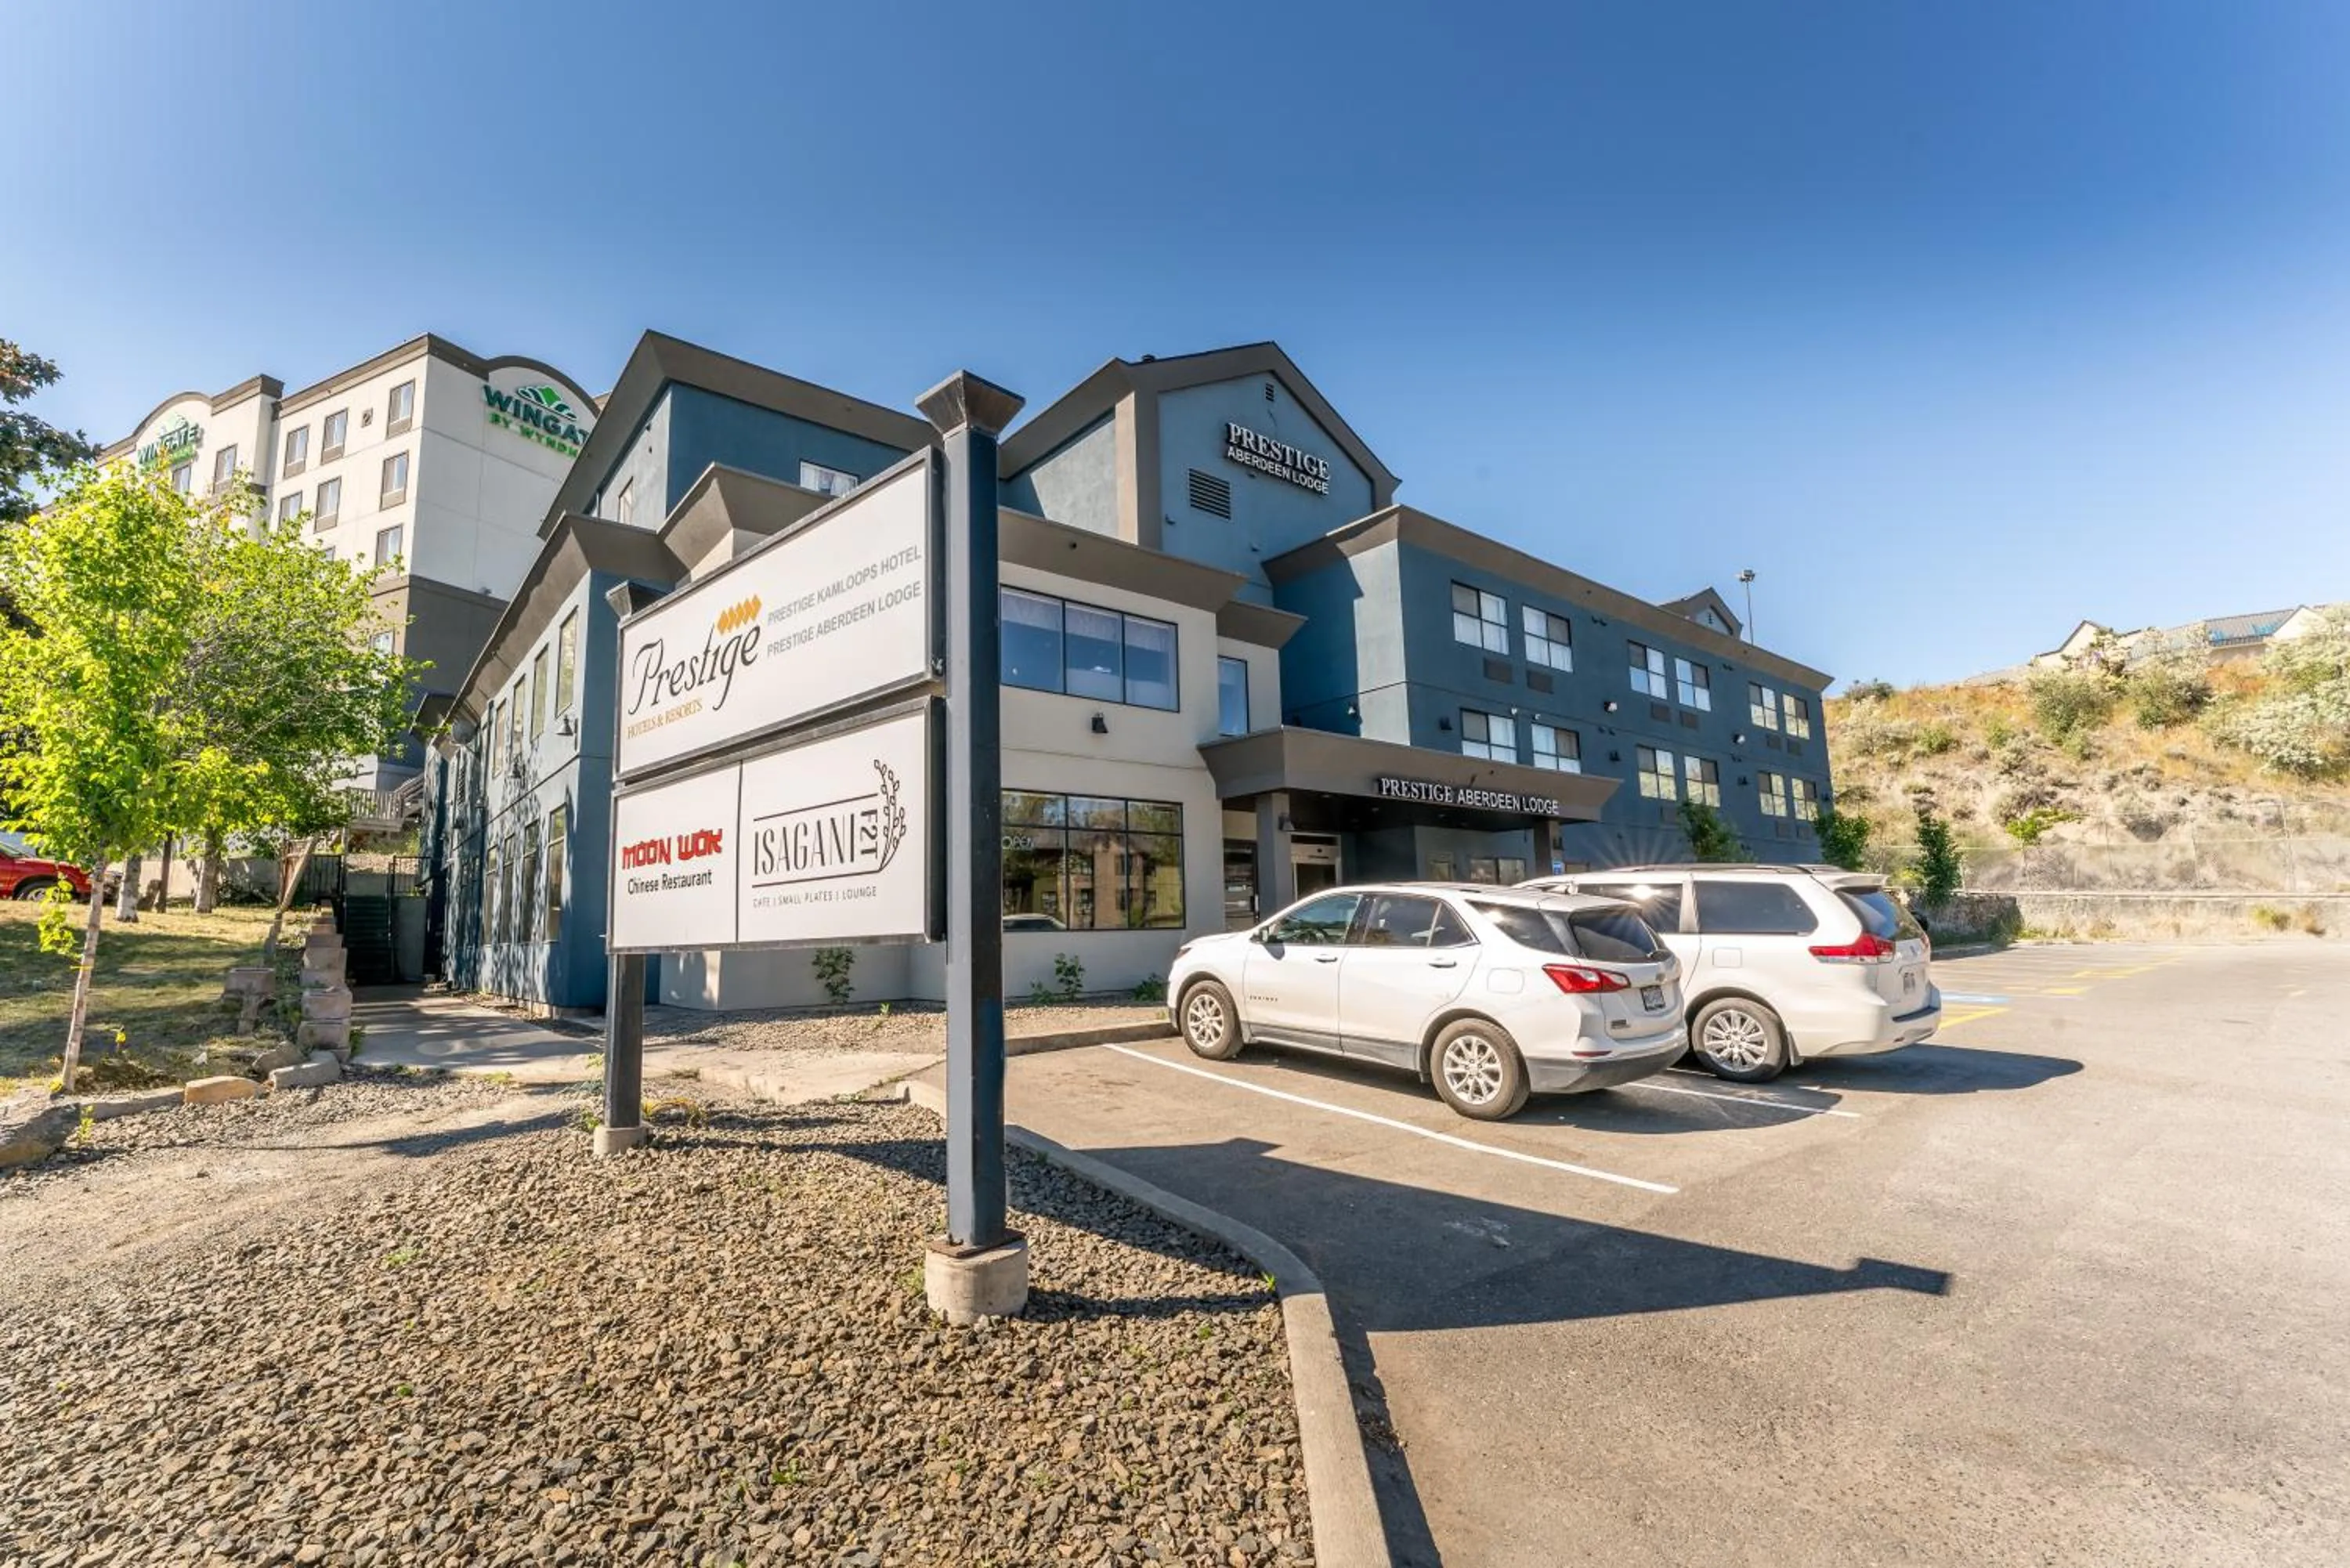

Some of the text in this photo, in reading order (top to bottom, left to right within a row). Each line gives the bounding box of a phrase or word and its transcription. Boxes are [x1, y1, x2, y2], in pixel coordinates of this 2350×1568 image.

[483, 385, 589, 446] WINGAT
[489, 411, 578, 458] BY WYNDH
[1227, 422, 1330, 481] PRESTIGE
[1227, 446, 1329, 495] ABERDEEN LODGE
[767, 544, 922, 627] PRESTIGE KAMLOOPS HOTEL
[767, 580, 922, 658] PRESTIGE ABERDEEN LODGE
[627, 623, 761, 715] Prestige
[627, 716, 656, 739] HOTELS
[665, 698, 703, 724] RESORTS
[1381, 777, 1559, 815] PRESTIGE ABERDEEN LODGE
[622, 829, 723, 870] MOON WOK
[754, 813, 855, 876] ISAGANI
[860, 808, 878, 859] F2T
[627, 869, 712, 894] Chinese Restaurant
[779, 894, 801, 906] SMALL
[804, 890, 833, 903] PLATES
[842, 886, 877, 901] LOUNGE
